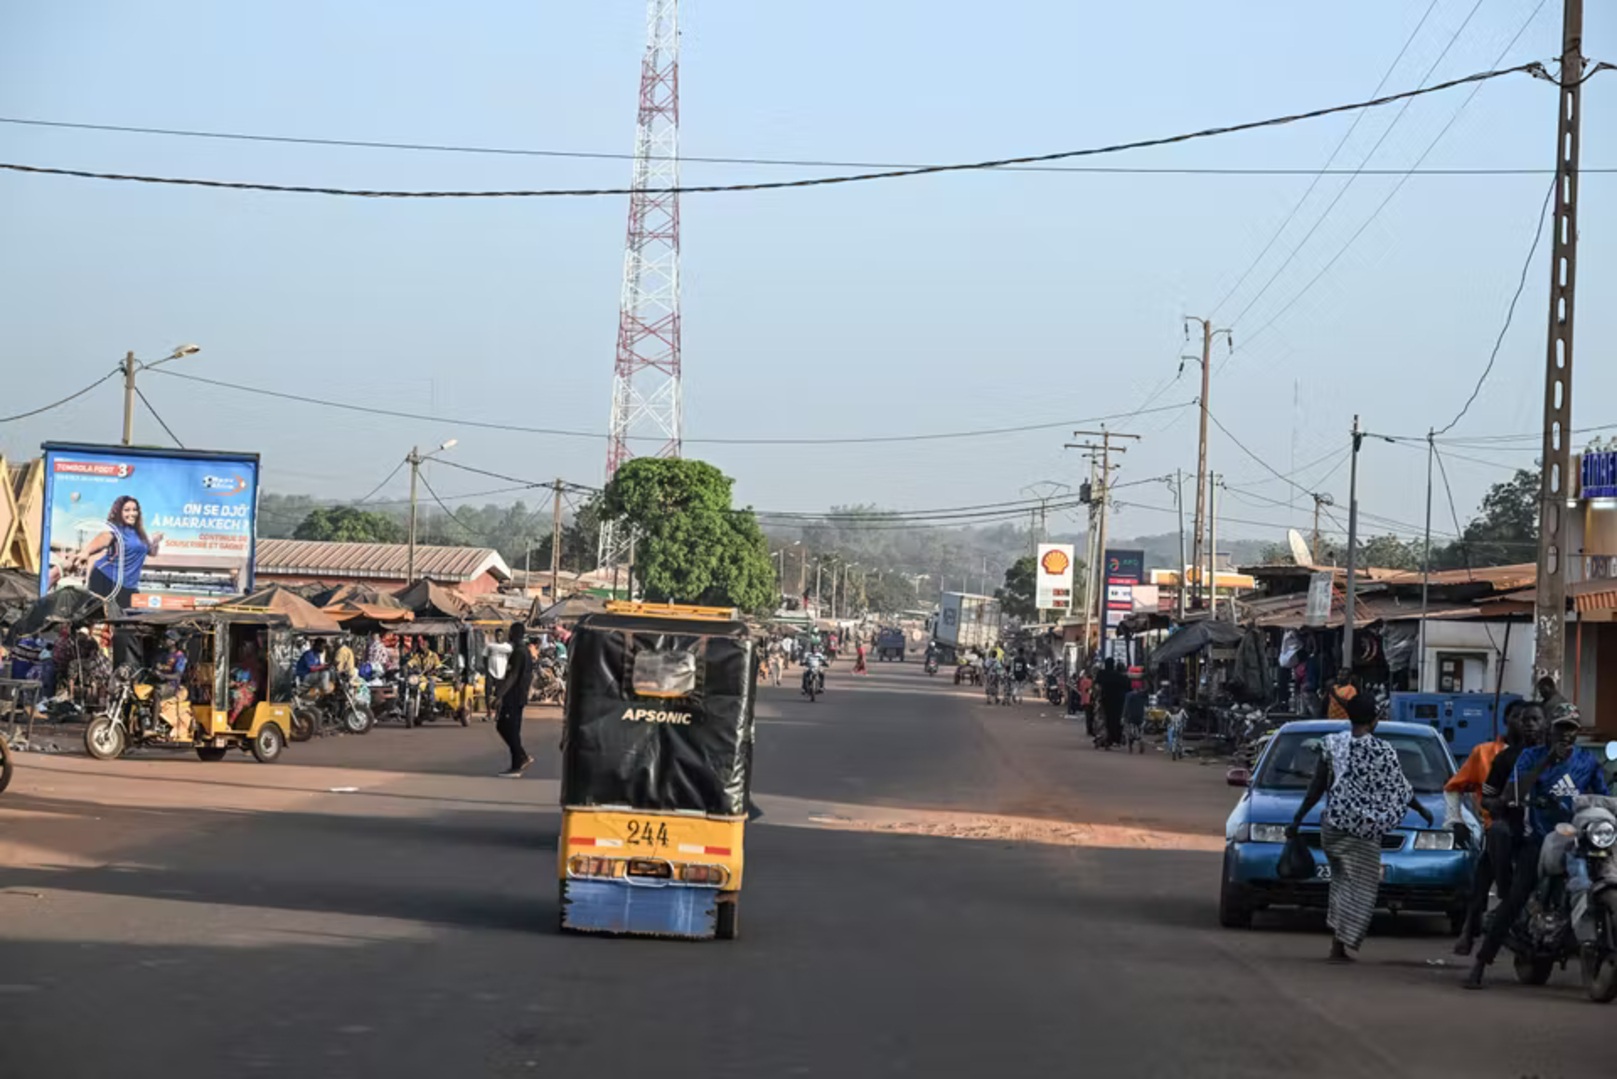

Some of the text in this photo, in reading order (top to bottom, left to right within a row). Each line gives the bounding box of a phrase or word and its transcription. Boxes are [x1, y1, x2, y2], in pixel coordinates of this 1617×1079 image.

[56, 463, 128, 477] TOMBOLA FOOT 3
[183, 503, 202, 515] ON
[203, 504, 220, 516] SE
[162, 515, 241, 531] MARRAKECH
[621, 708, 692, 725] APSONIC
[626, 819, 669, 847] 244
